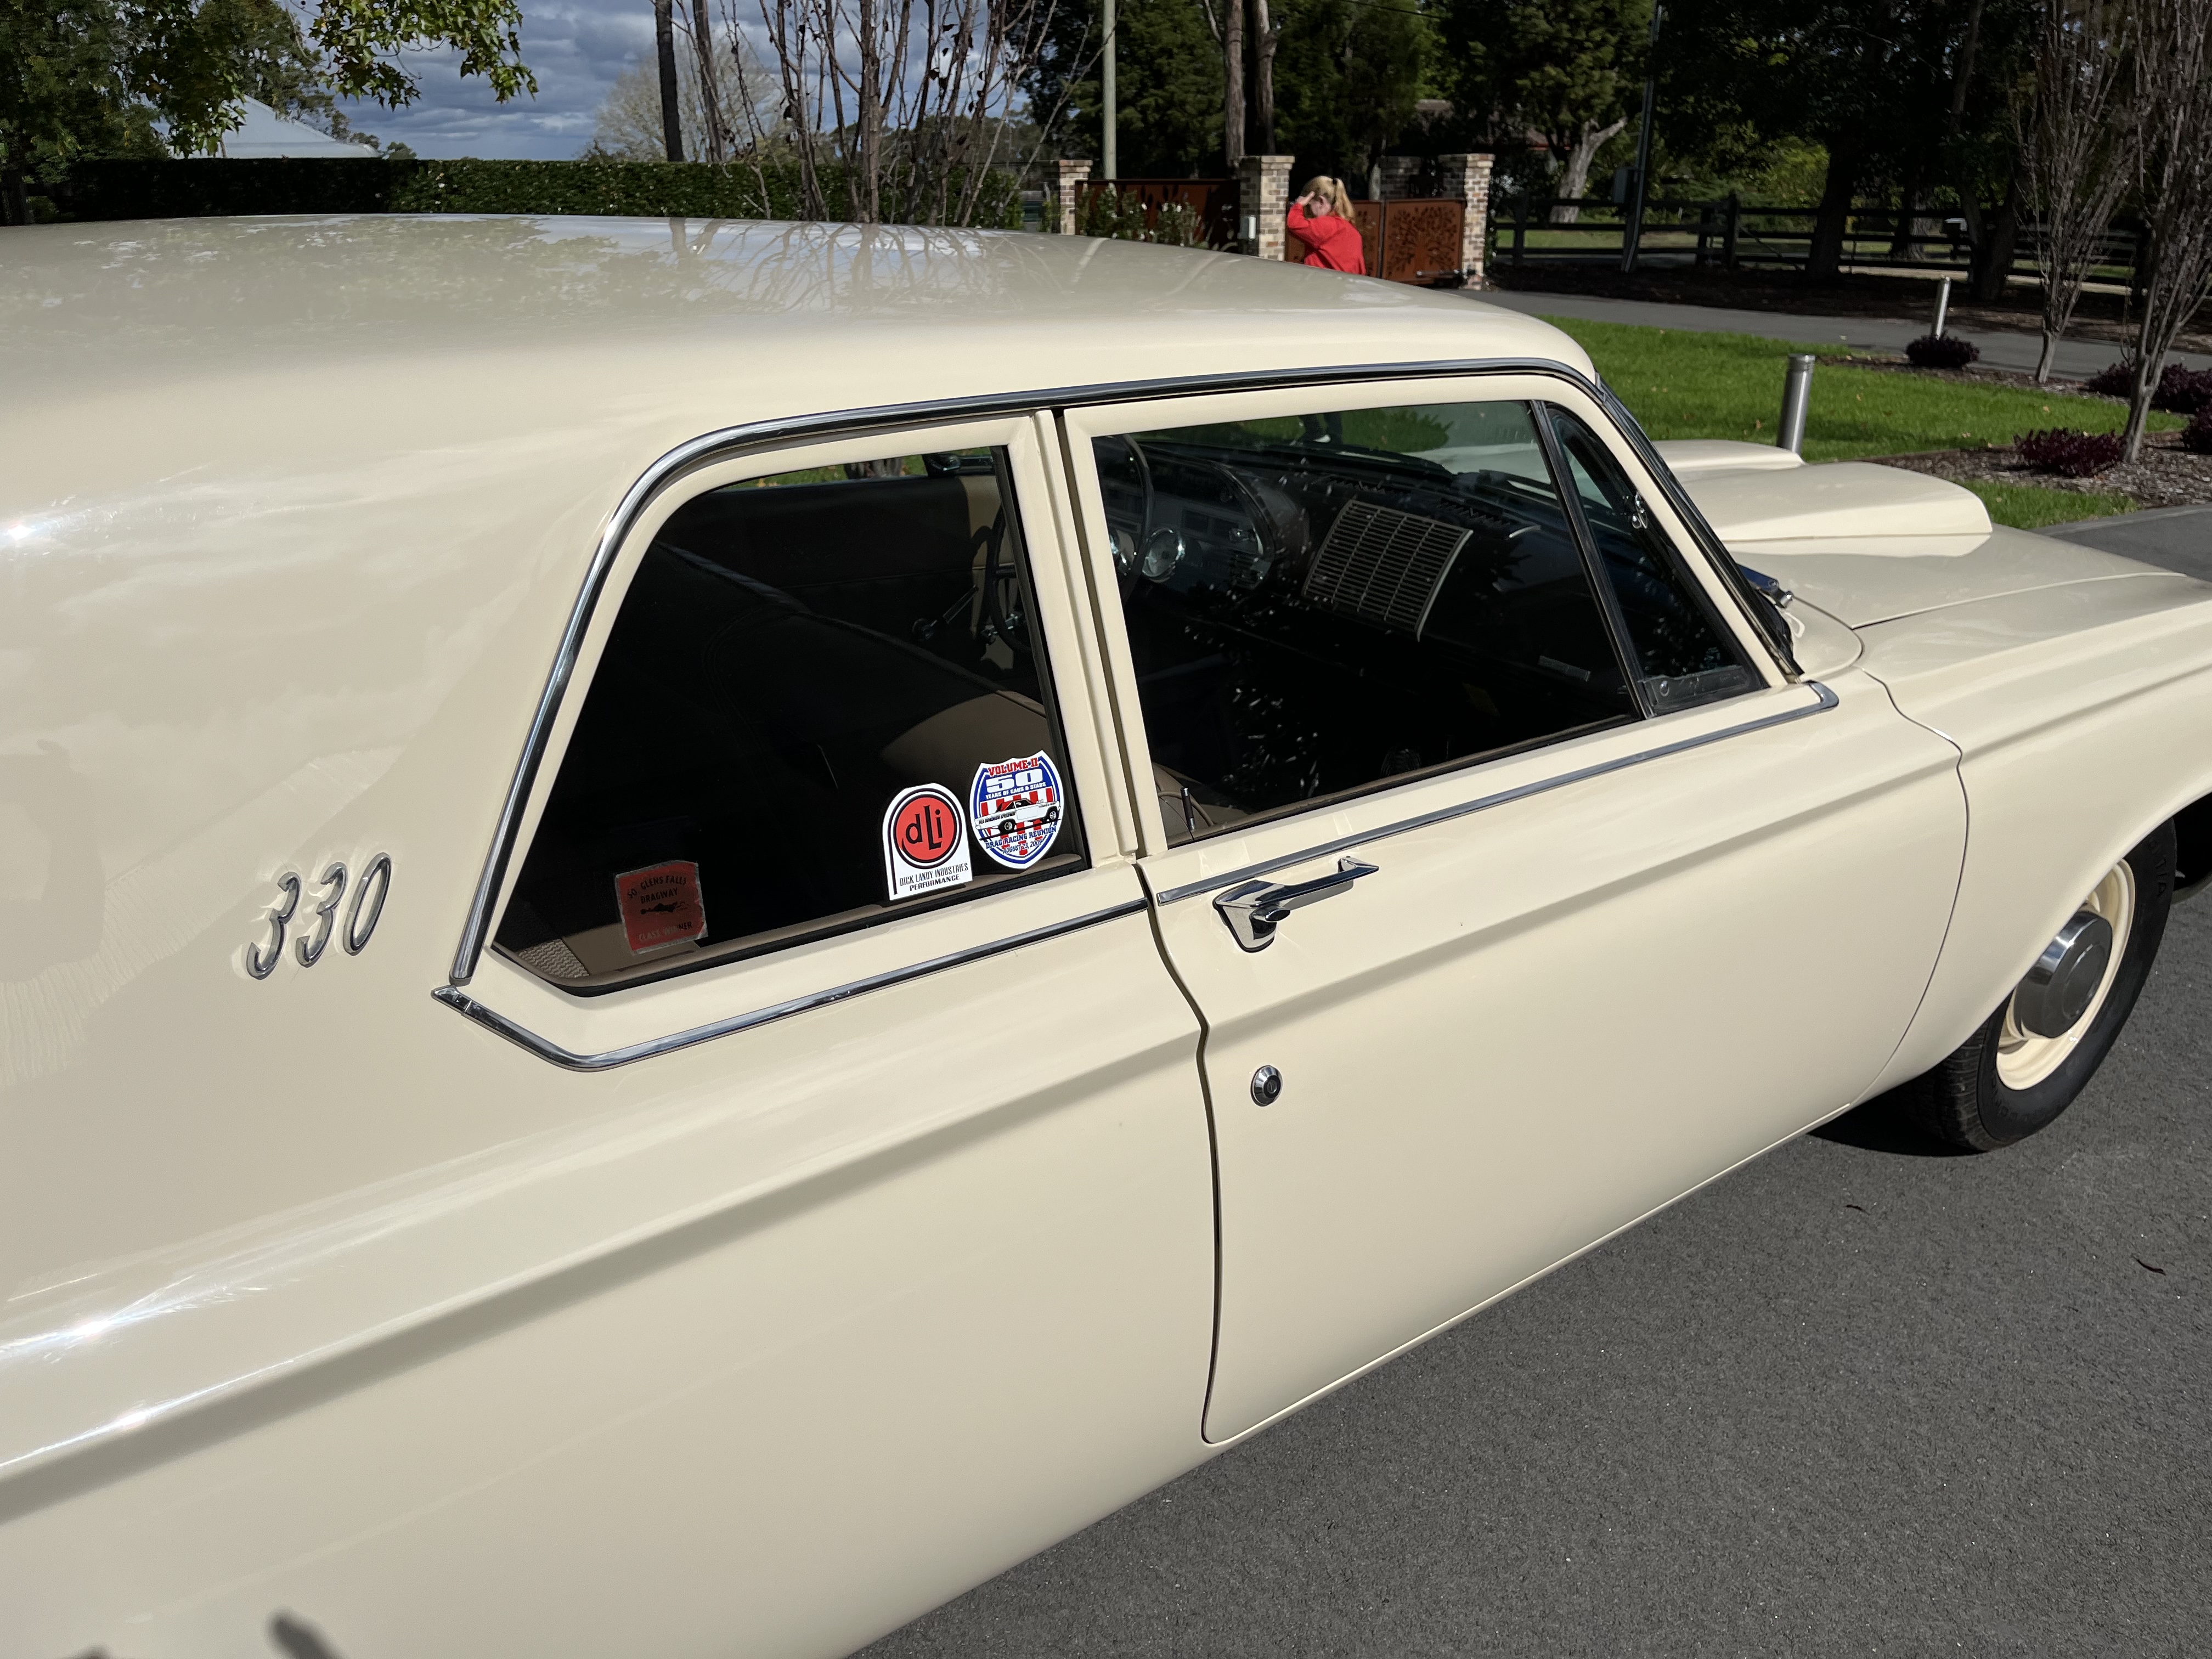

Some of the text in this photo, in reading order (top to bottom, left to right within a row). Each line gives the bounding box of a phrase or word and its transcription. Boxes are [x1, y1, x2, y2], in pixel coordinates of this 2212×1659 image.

[988, 760, 1028, 776] VOLUME
[986, 769, 1043, 793] 50
[985, 826, 1057, 849] DRAG RACING REUNION
[1003, 845, 1021, 854] AUGUST
[665, 875, 687, 886] FALLS
[900, 862, 968, 886] DICK LANDY INDUSTRIES
[910, 874, 960, 891] PERFORMANCE
[640, 887, 678, 904] DRAGWAY
[247, 852, 392, 980] 330
